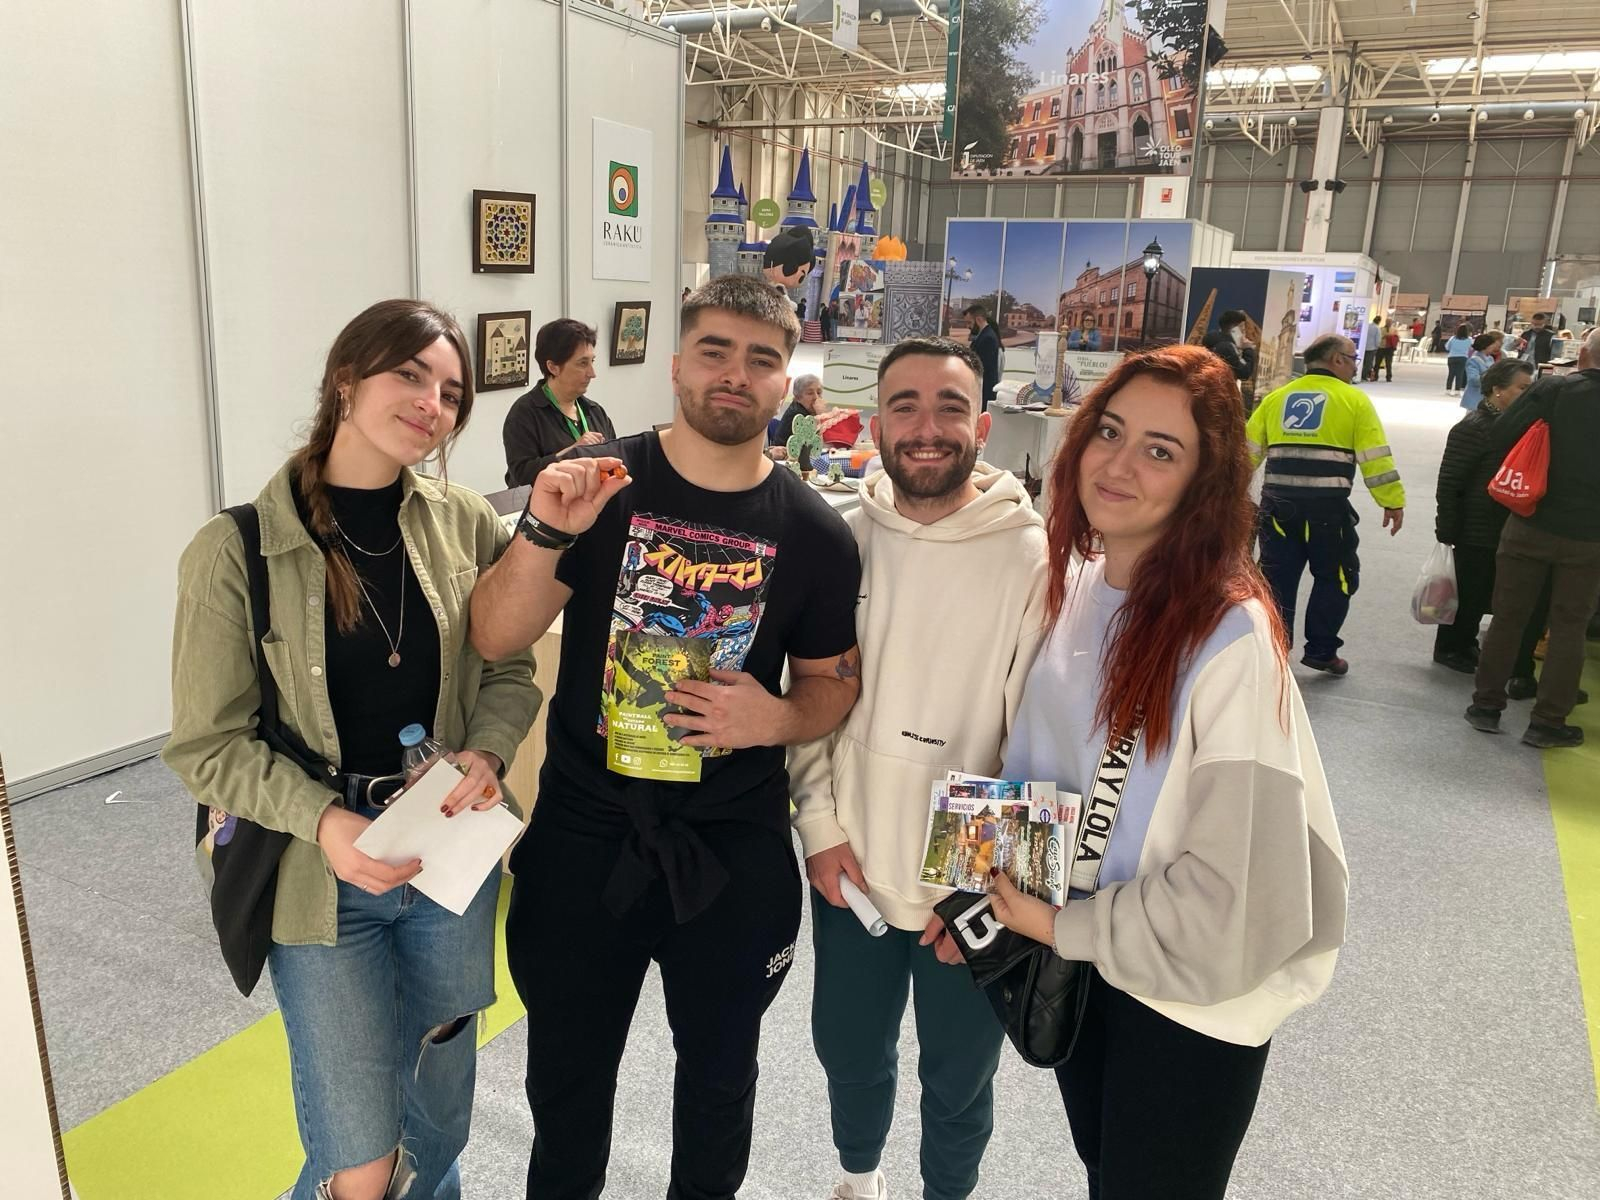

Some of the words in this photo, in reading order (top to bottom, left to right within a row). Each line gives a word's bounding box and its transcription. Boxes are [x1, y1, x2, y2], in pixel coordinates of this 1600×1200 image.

[1040, 70, 1109, 85] Linares
[654, 523, 688, 537] MARVEL
[689, 532, 720, 543] COMICS
[643, 543, 763, 592] スパイダーマン
[642, 657, 681, 667] FOREST
[618, 711, 652, 720] PAINTBALL
[612, 720, 658, 733] NATURAL
[948, 802, 975, 811] SERVICIOS
[1076, 796, 1117, 862] LOLA
